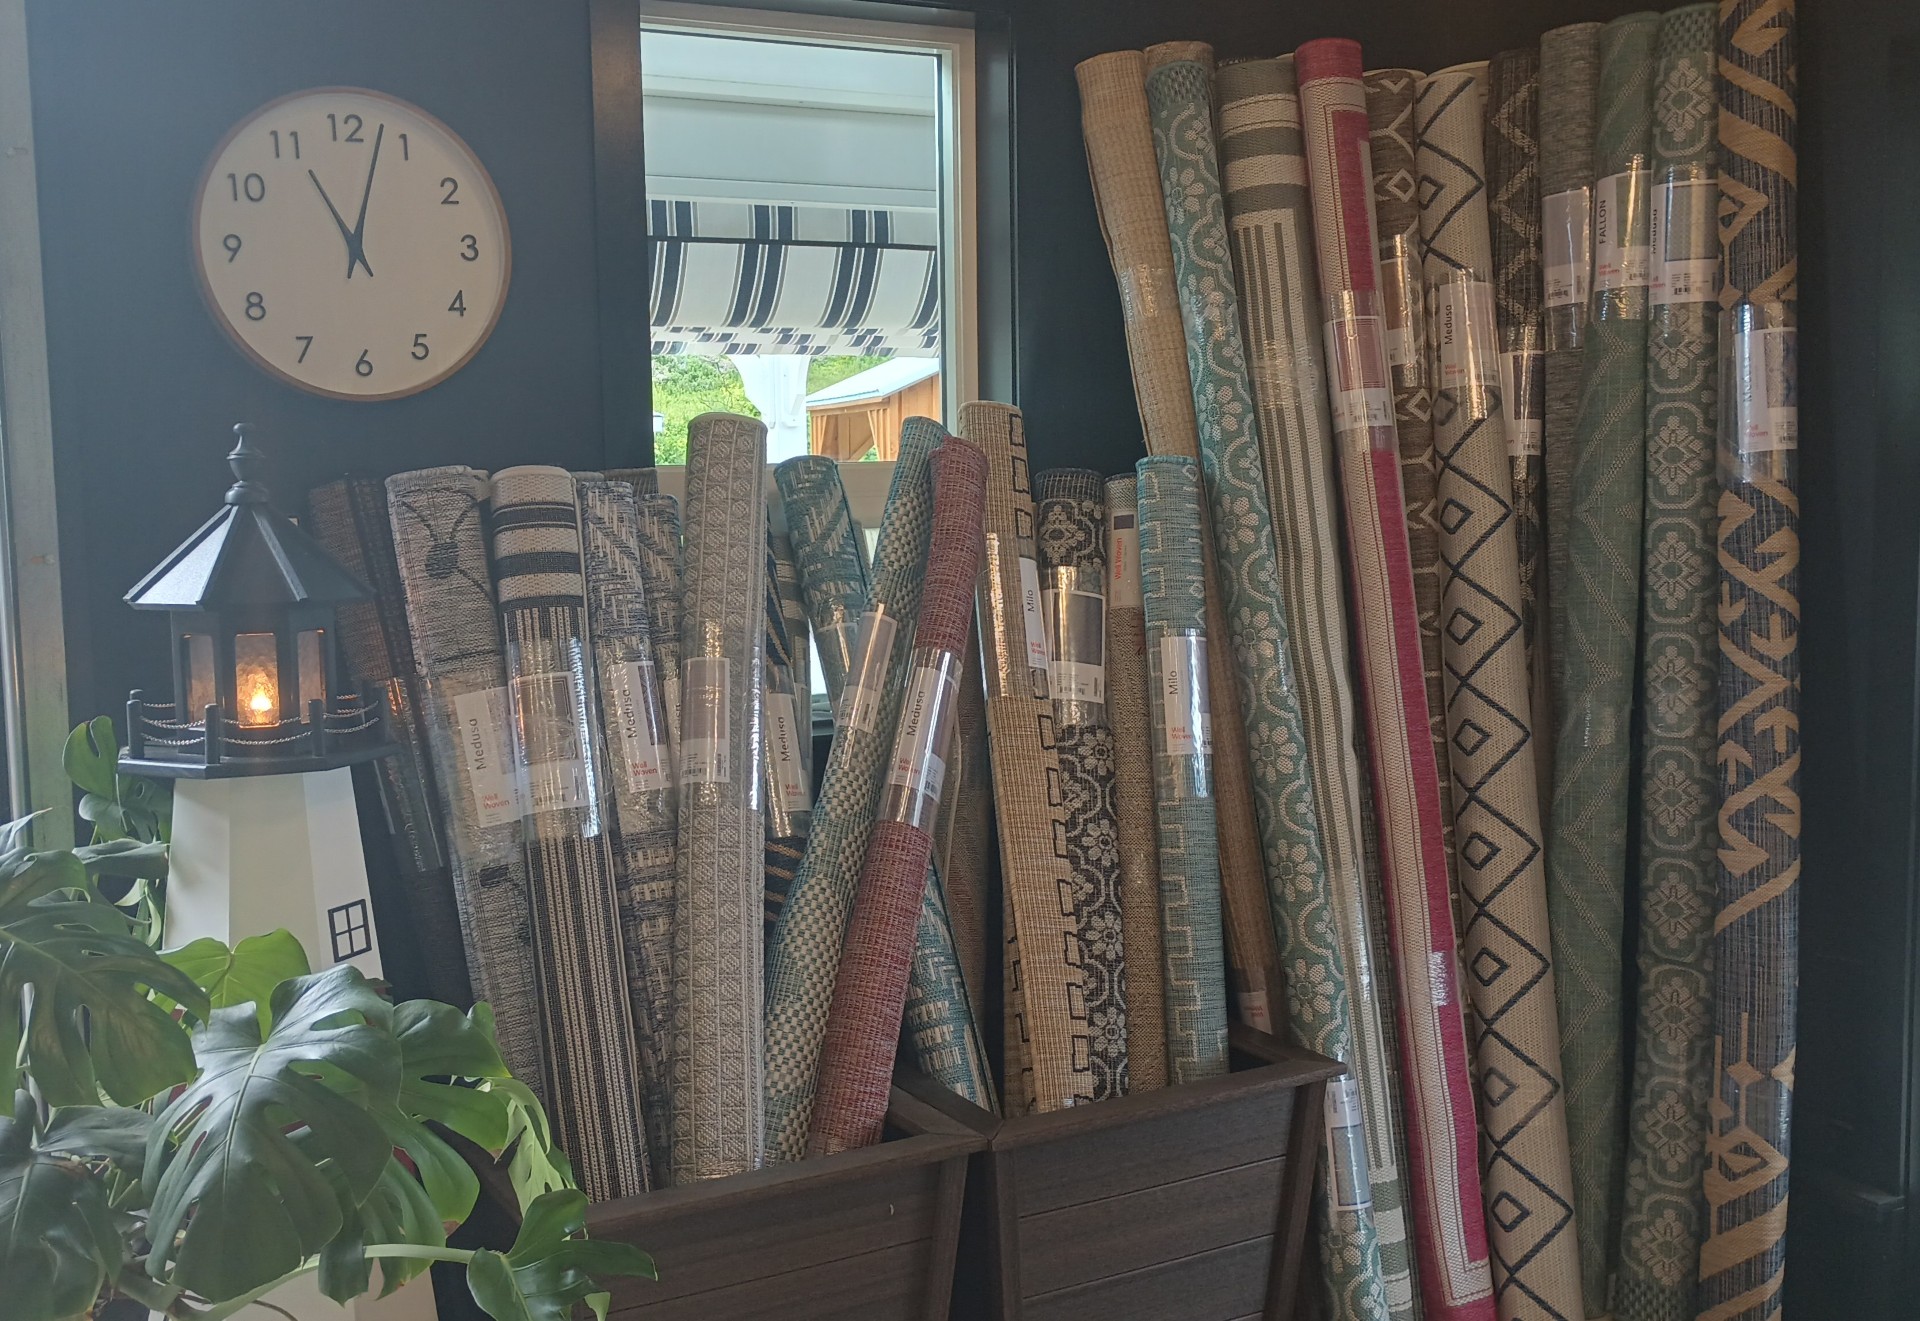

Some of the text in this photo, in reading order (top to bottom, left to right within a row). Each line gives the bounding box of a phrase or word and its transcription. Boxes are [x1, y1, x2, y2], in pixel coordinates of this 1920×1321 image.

[327, 113, 364, 143] 12
[269, 130, 300, 160] 11
[398, 133, 409, 161] 1
[227, 173, 266, 202] 10
[439, 177, 460, 205] 2
[1598, 200, 1606, 245] FALLON
[222, 234, 242, 263] 9
[460, 234, 479, 261] 3
[244, 291, 266, 321] 8
[447, 290, 466, 317] 4
[1444, 304, 1453, 345] Medusa
[295, 336, 313, 363] 7
[411, 333, 430, 360] 5
[355, 349, 374, 377] 6
[1115, 538, 1123, 564] Woven
[1026, 590, 1034, 613] Milo
[1168, 670, 1179, 695] Milo
[622, 690, 638, 739] Medusa
[907, 691, 925, 737] Medusa
[469, 718, 487, 771] Medusa
[778, 716, 791, 762] Medusa
[631, 761, 648, 770] Well
[633, 767, 658, 777] Woven
[483, 800, 510, 810] Woven
